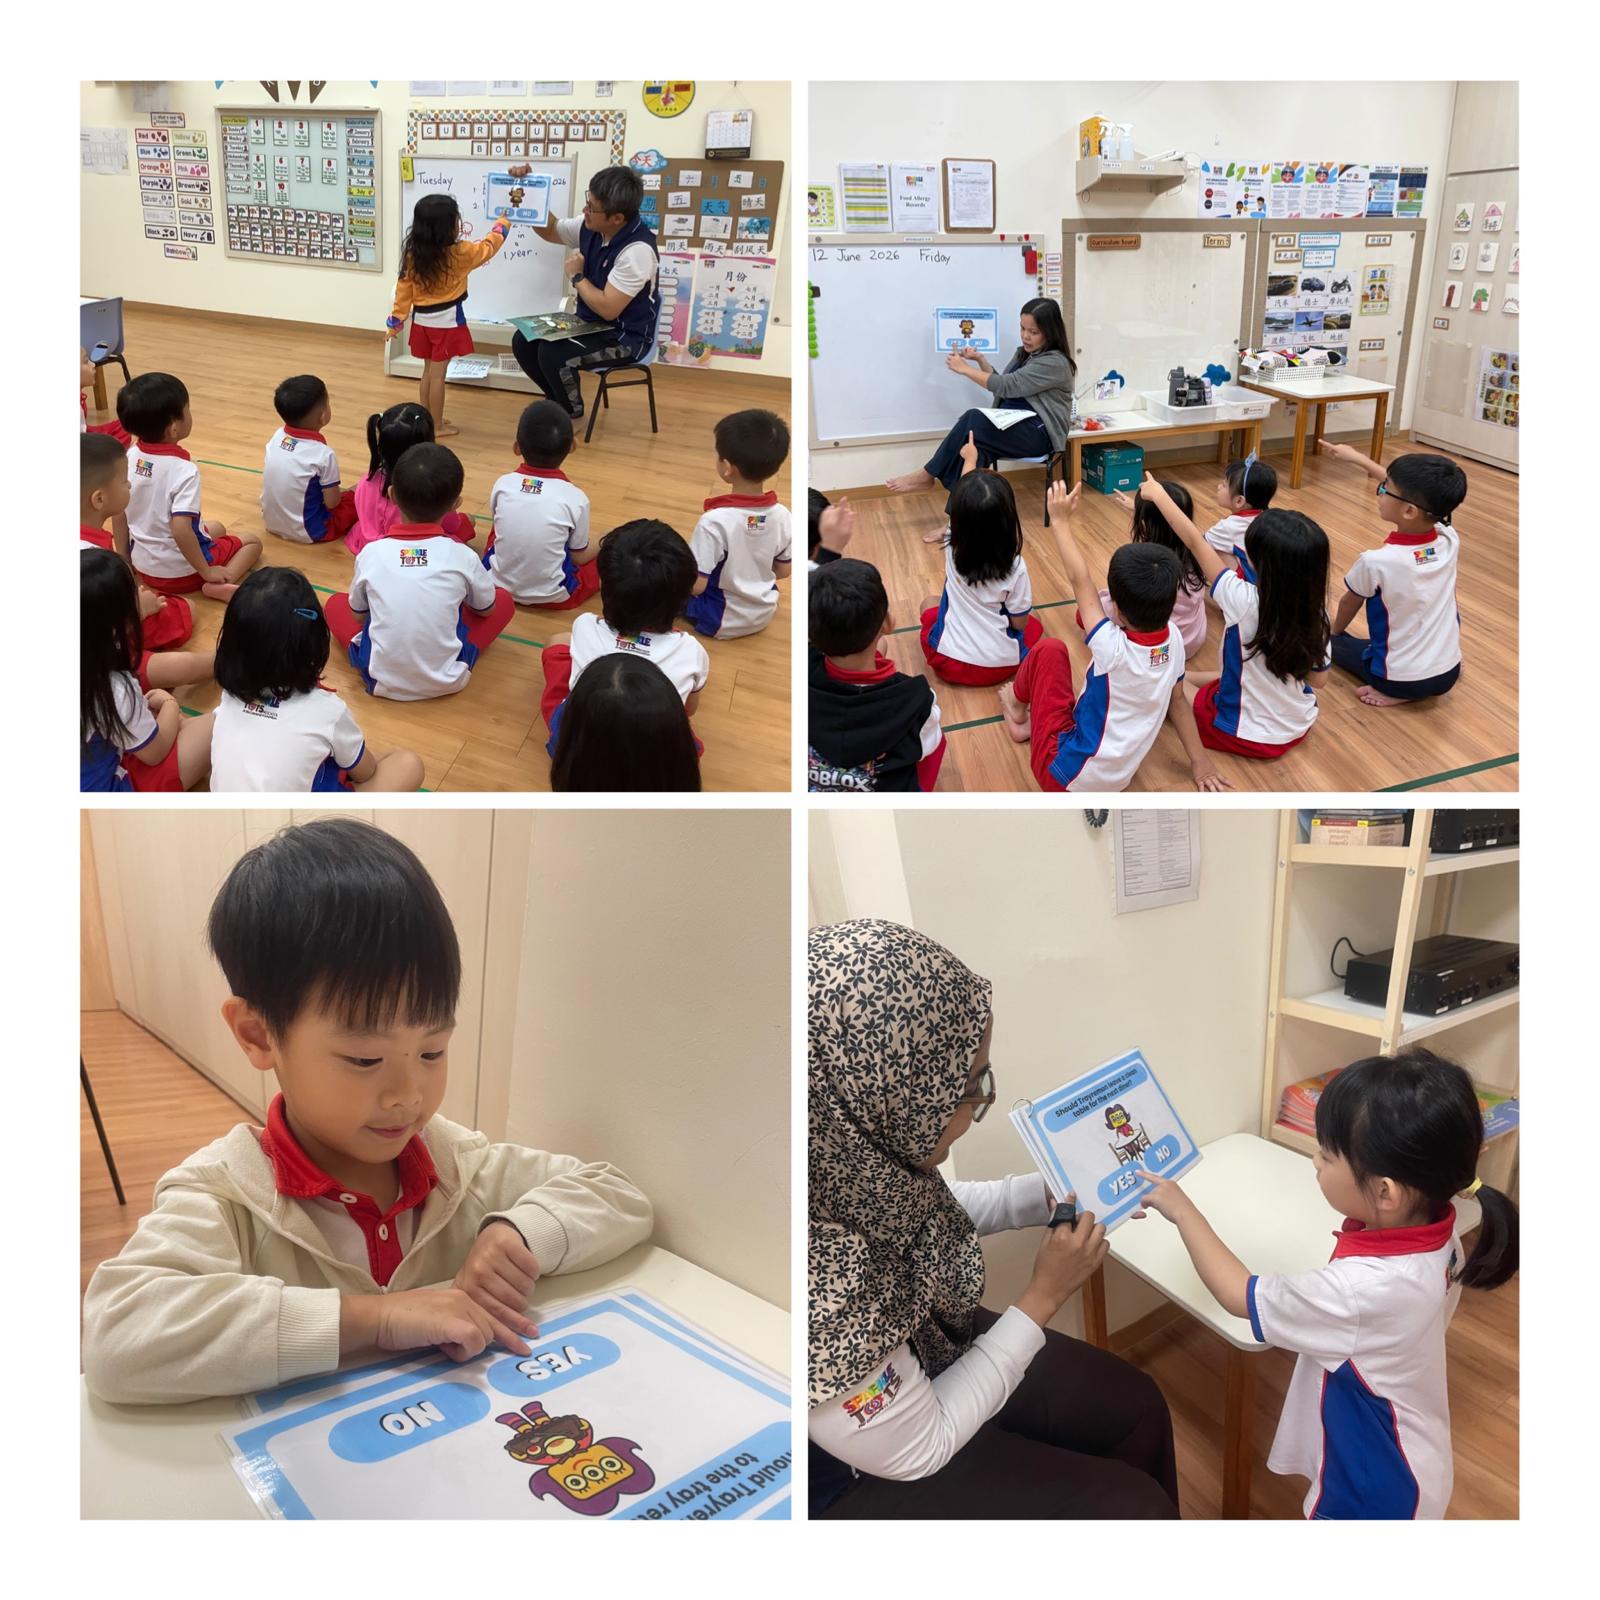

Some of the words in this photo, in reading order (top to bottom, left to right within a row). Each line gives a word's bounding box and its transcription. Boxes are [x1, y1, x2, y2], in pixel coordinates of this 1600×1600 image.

[427, 126, 600, 136] CURRICULUM
[478, 145, 559, 154] BOARD
[141, 163, 160, 171] Orange
[631, 154, 653, 168] 今天
[416, 172, 454, 191] Tuesday
[552, 177, 566, 186] 026
[672, 194, 688, 206] 五
[703, 200, 728, 214] 天气
[742, 196, 764, 208] 晴天
[518, 231, 524, 239] in
[166, 247, 187, 255] Rainbow
[666, 240, 688, 252] 阴天
[704, 242, 725, 256] 雨天
[733, 244, 768, 256] 刮风天
[812, 248, 828, 262] 12
[836, 248, 862, 262] June
[870, 250, 900, 260] 2026
[920, 248, 951, 265] Friday
[725, 271, 747, 282] 月份
[808, 768, 871, 792] OBLOX
[1055, 1101, 1079, 1117] Should
[1078, 1085, 1108, 1104] Trayremon
[1072, 1104, 1090, 1118] table
[1089, 1100, 1098, 1108] for
[1097, 1095, 1108, 1104] the
[1107, 1088, 1119, 1098] next
[1109, 1171, 1137, 1196] YES
[1155, 1144, 1172, 1163] NO
[516, 1346, 592, 1381] YES
[380, 1401, 446, 1436] NO
[734, 1452, 760, 1467] to
[706, 1464, 741, 1484] the
[748, 1449, 792, 1488] hould
[666, 1480, 712, 1509] tray
[680, 1483, 757, 1520] Trayre
[630, 1503, 671, 1520] ret
